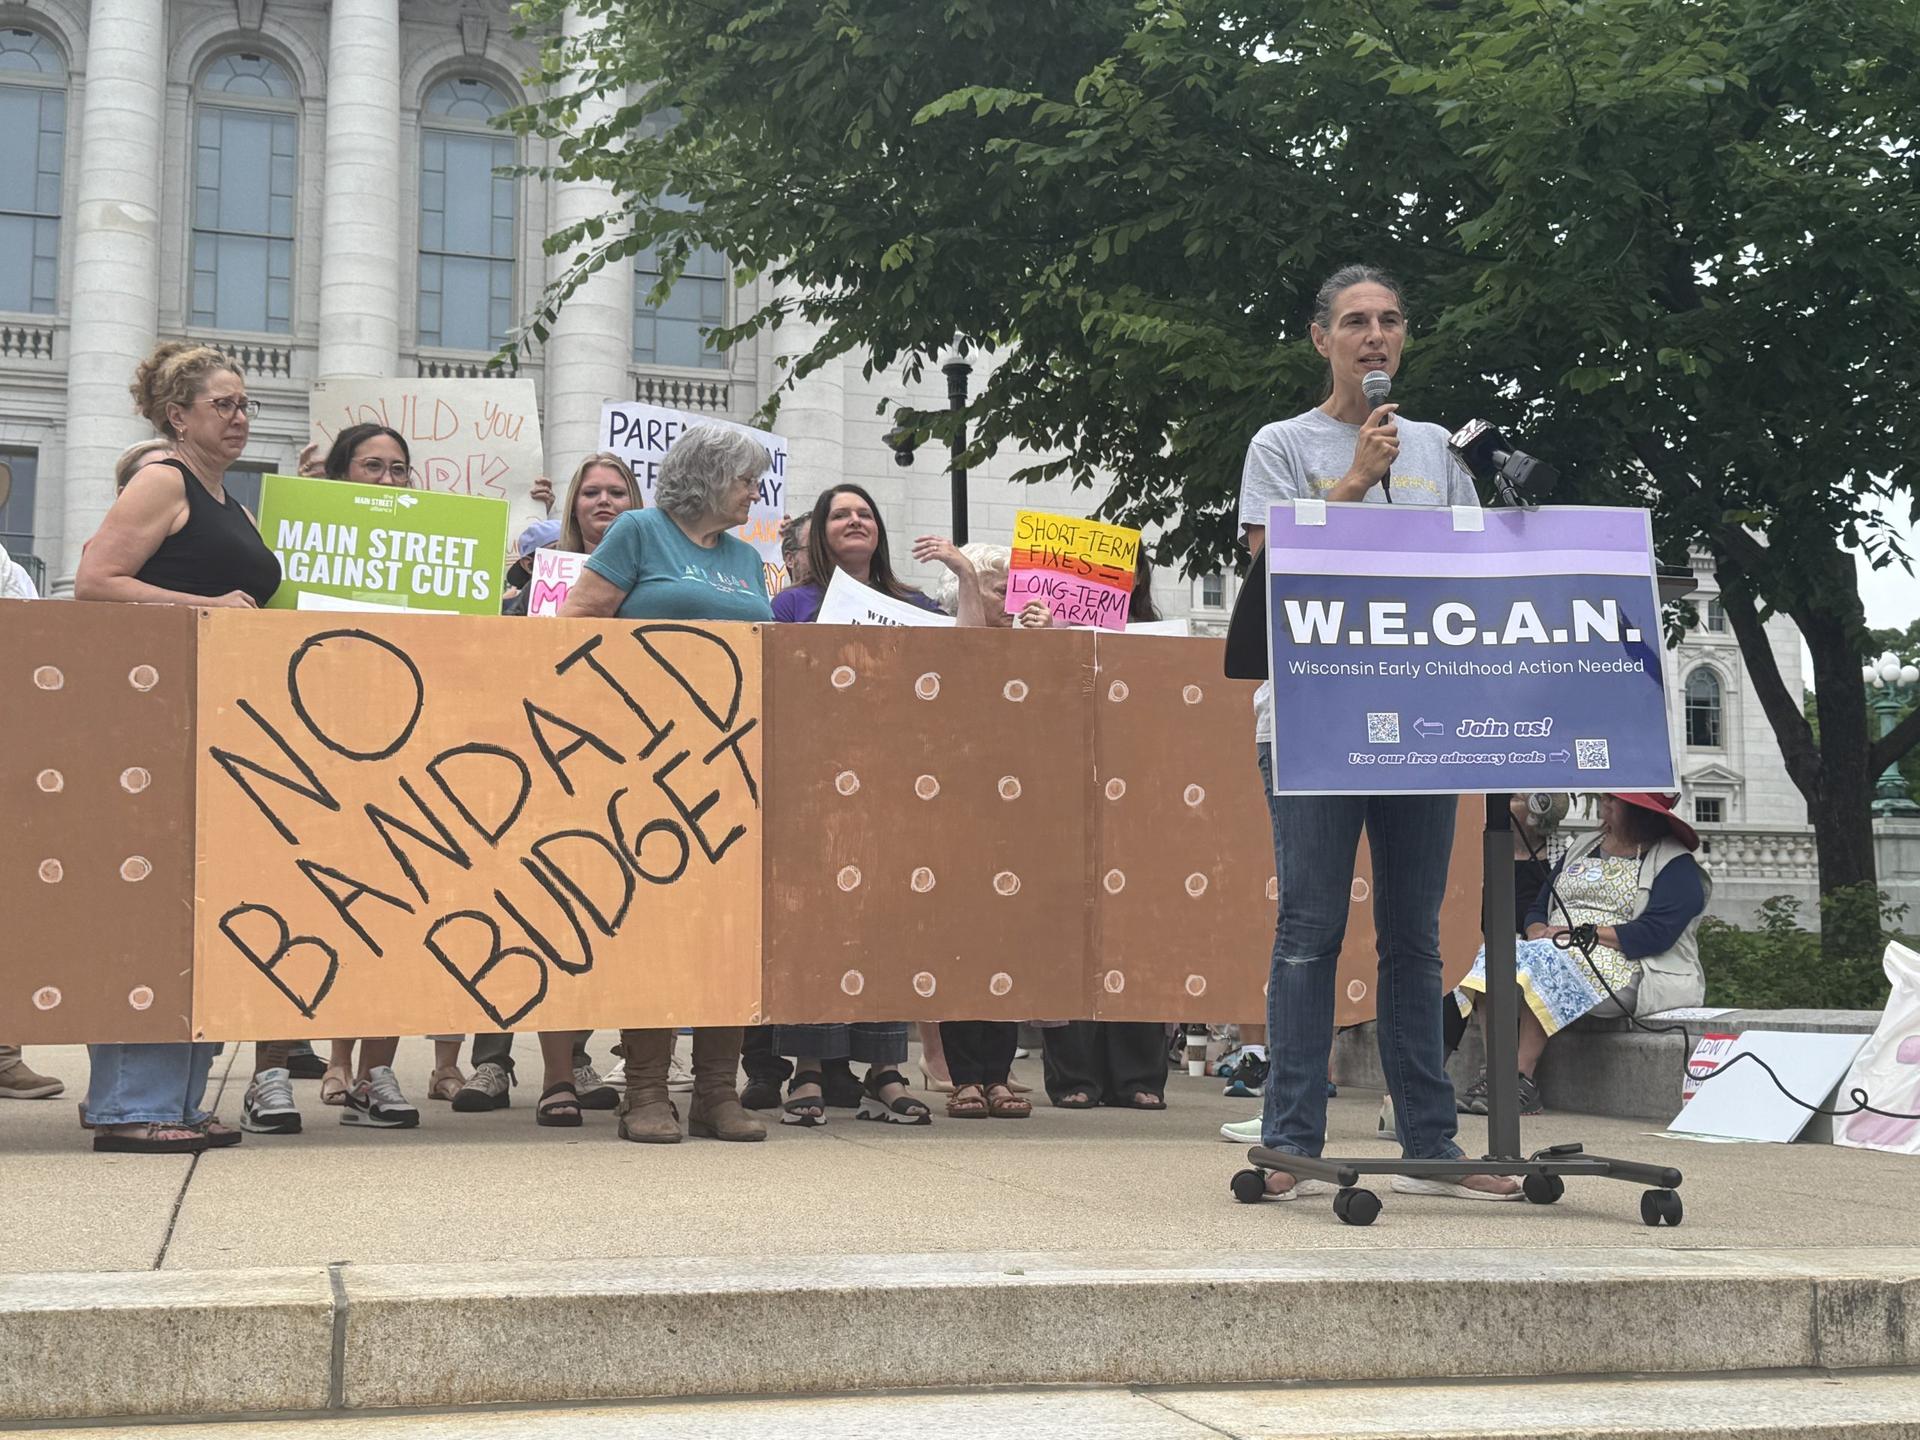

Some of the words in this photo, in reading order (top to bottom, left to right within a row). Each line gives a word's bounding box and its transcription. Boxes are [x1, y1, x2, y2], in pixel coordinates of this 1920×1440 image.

[609, 411, 687, 452] PARE
[354, 496, 370, 505] MAIN
[371, 498, 393, 508] STREET
[277, 519, 358, 556] MAIN
[368, 528, 479, 568] STREET
[1018, 515, 1136, 565] SHORT-TERM
[1029, 544, 1092, 575] FIXES
[274, 550, 403, 591] AGAINST
[411, 563, 490, 600] CUTS
[537, 553, 574, 579] WE
[1012, 574, 1127, 620] LONG-TERM
[1040, 598, 1105, 628] ARM!
[1284, 599, 1642, 646] W.E.C.A.N.
[1288, 660, 1374, 676] Wisconsin
[1378, 661, 1420, 679] Early
[1425, 659, 1513, 676] Childhood
[1518, 659, 1575, 675] Action
[1578, 658, 1645, 674] Needed
[208, 628, 425, 846] NO
[1456, 717, 1510, 738] Join
[1514, 716, 1554, 738] us!
[1348, 752, 1375, 765] Use
[1378, 752, 1405, 764] our
[1406, 751, 1437, 766] free
[1440, 750, 1506, 766] advocacy
[1508, 750, 1546, 763] tools
[424, 717, 760, 1030] BUDGET
